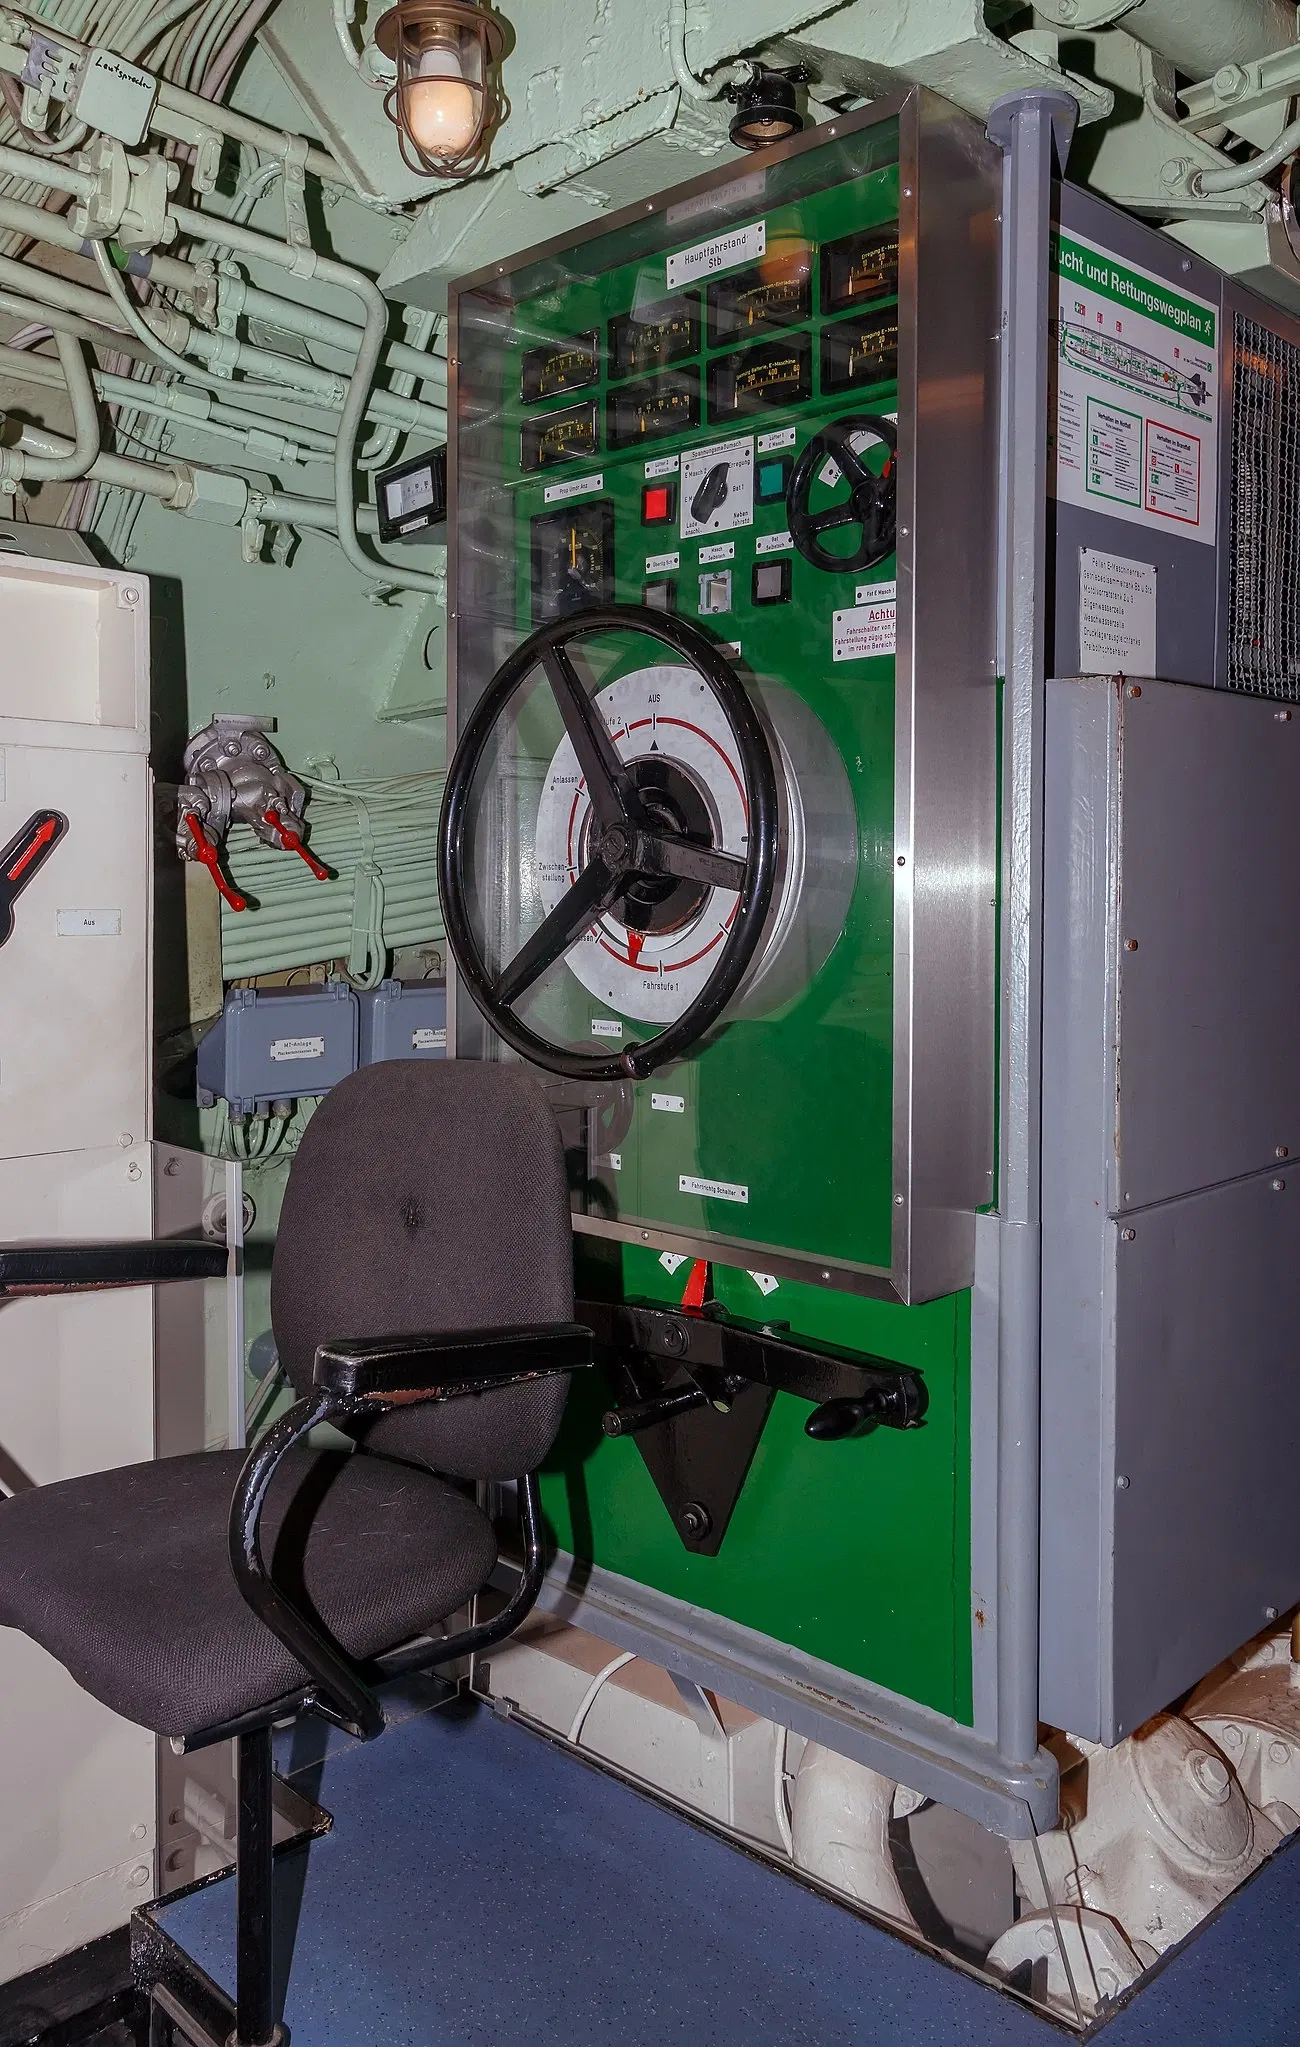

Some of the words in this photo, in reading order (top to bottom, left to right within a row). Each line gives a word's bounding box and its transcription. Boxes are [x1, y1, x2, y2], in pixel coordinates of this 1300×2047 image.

[684, 234, 748, 265] Hauptfahrstand
[708, 257, 722, 269] Stb
[1086, 266, 1108, 286] und
[1111, 272, 1202, 331] Rettungswegplan
[728, 459, 751, 468] Erregung
[869, 608, 895, 620] Achtu
[846, 625, 880, 635] Fahrschalter
[834, 636, 867, 645] Fahrstellung
[868, 633, 883, 641] zügig
[871, 642, 892, 650] Bereich
[648, 694, 661, 703] AUS
[617, 716, 622, 725] 2
[553, 776, 578, 784] Anlassen
[539, 862, 567, 871] Zwischen-
[542, 874, 565, 883] stellung
[83, 918, 95, 926] Aus
[643, 980, 674, 991] Fahrstufe
[675, 982, 679, 991] 1
[717, 1187, 737, 1195] Schalter
